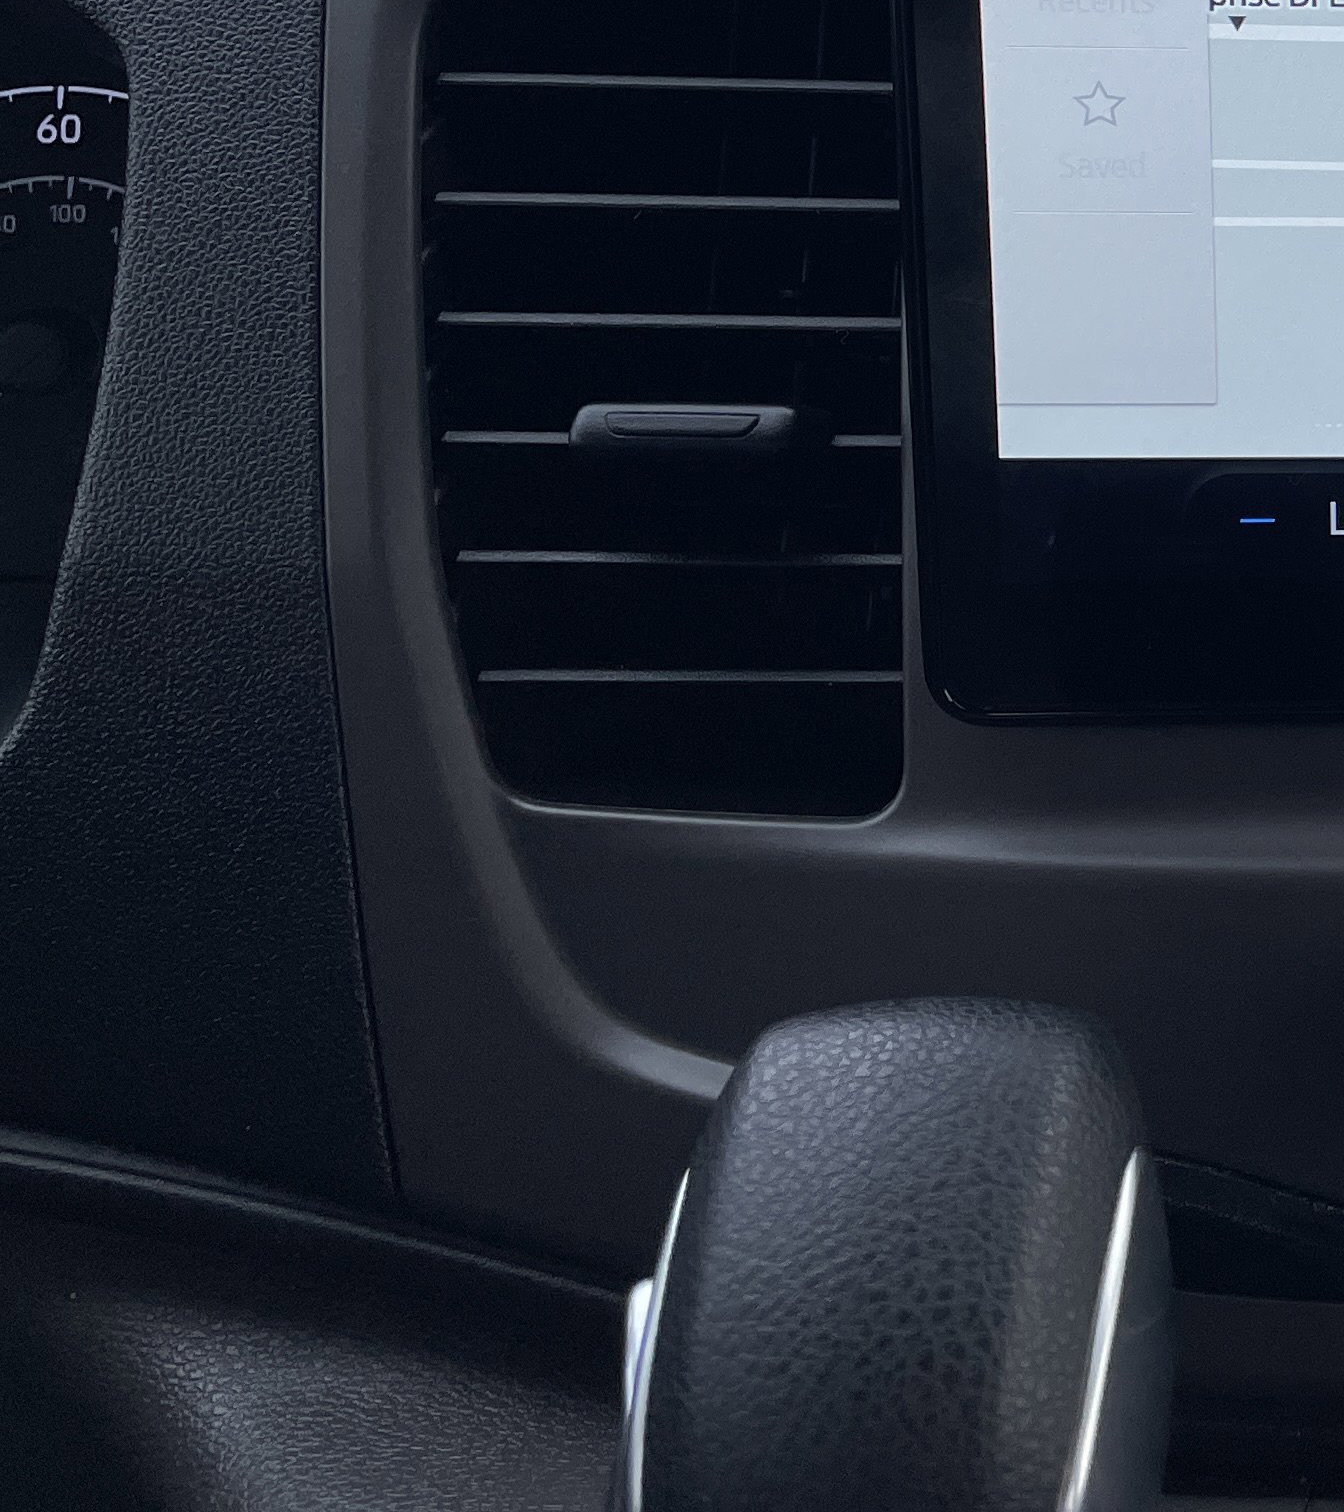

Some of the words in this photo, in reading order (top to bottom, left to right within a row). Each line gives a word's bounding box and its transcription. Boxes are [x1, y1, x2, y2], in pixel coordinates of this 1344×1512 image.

[37, 114, 81, 143] 60
[1058, 150, 1147, 180] Saved
[50, 204, 87, 223] 100
